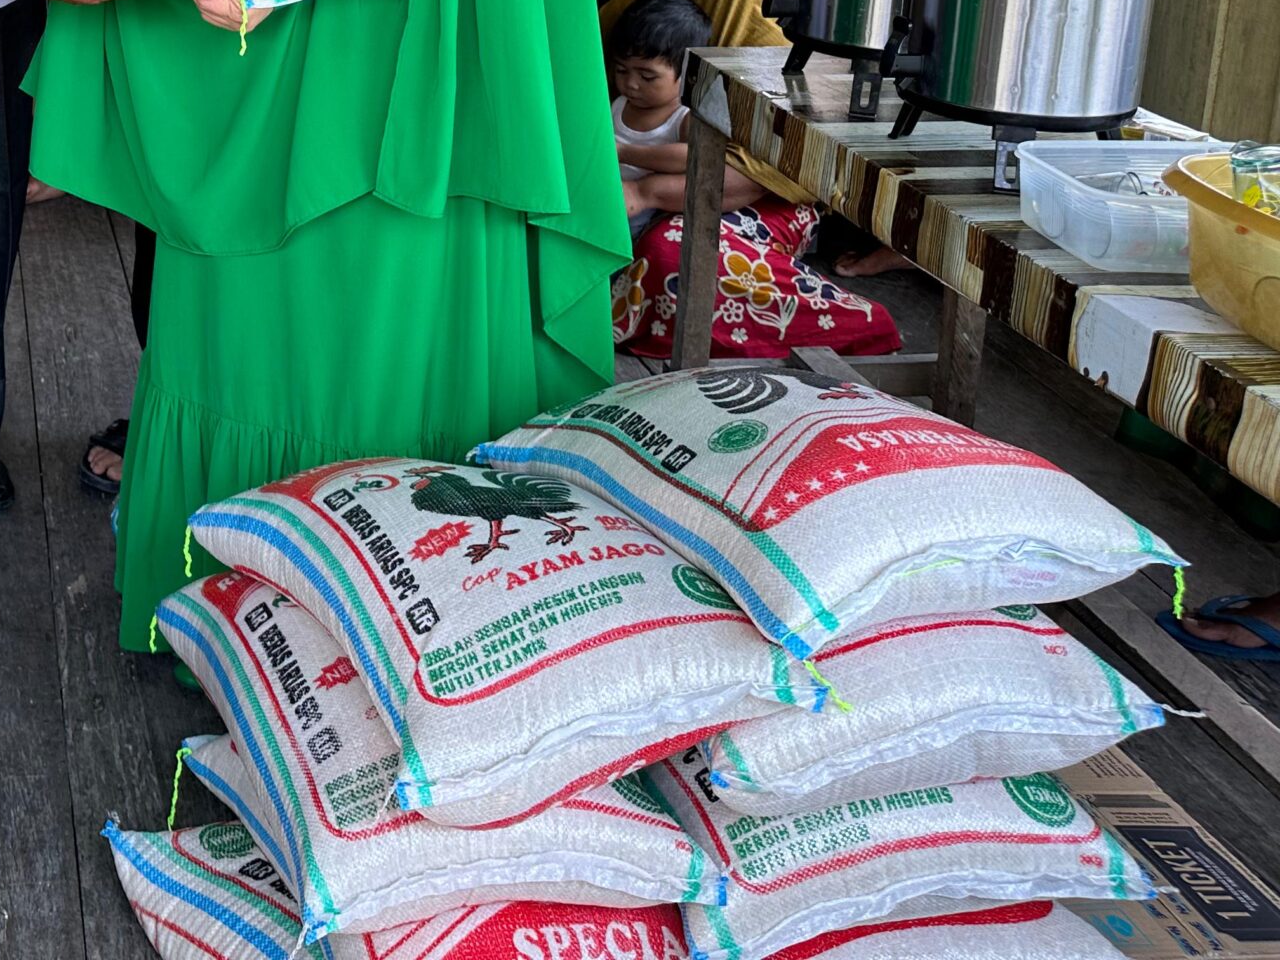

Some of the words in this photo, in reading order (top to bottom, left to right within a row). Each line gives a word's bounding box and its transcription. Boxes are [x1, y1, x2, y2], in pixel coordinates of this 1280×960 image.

[616, 411, 654, 442] ARIAS
[640, 430, 673, 456] SPC
[835, 429, 962, 453] PERKASA
[341, 504, 381, 540] BERAS
[365, 533, 405, 576] ARIAS
[389, 567, 420, 601] SPC
[419, 526, 459, 554] NEW
[461, 566, 503, 592] Cap
[505, 550, 586, 591] AYAM
[588, 542, 665, 562] JAGO
[258, 623, 293, 668] BERAS
[428, 650, 480, 683] BERSIH
[483, 628, 526, 659] SEHAT
[530, 612, 560, 636] DAN
[275, 658, 311, 705] ARIAS
[432, 670, 475, 697] MUTU
[733, 824, 791, 860] BERSIH
[847, 797, 884, 819] DAN
[884, 786, 954, 811] HIGIENIS
[1141, 837, 1235, 905] TICKET
[512, 920, 689, 960] SPECIA
